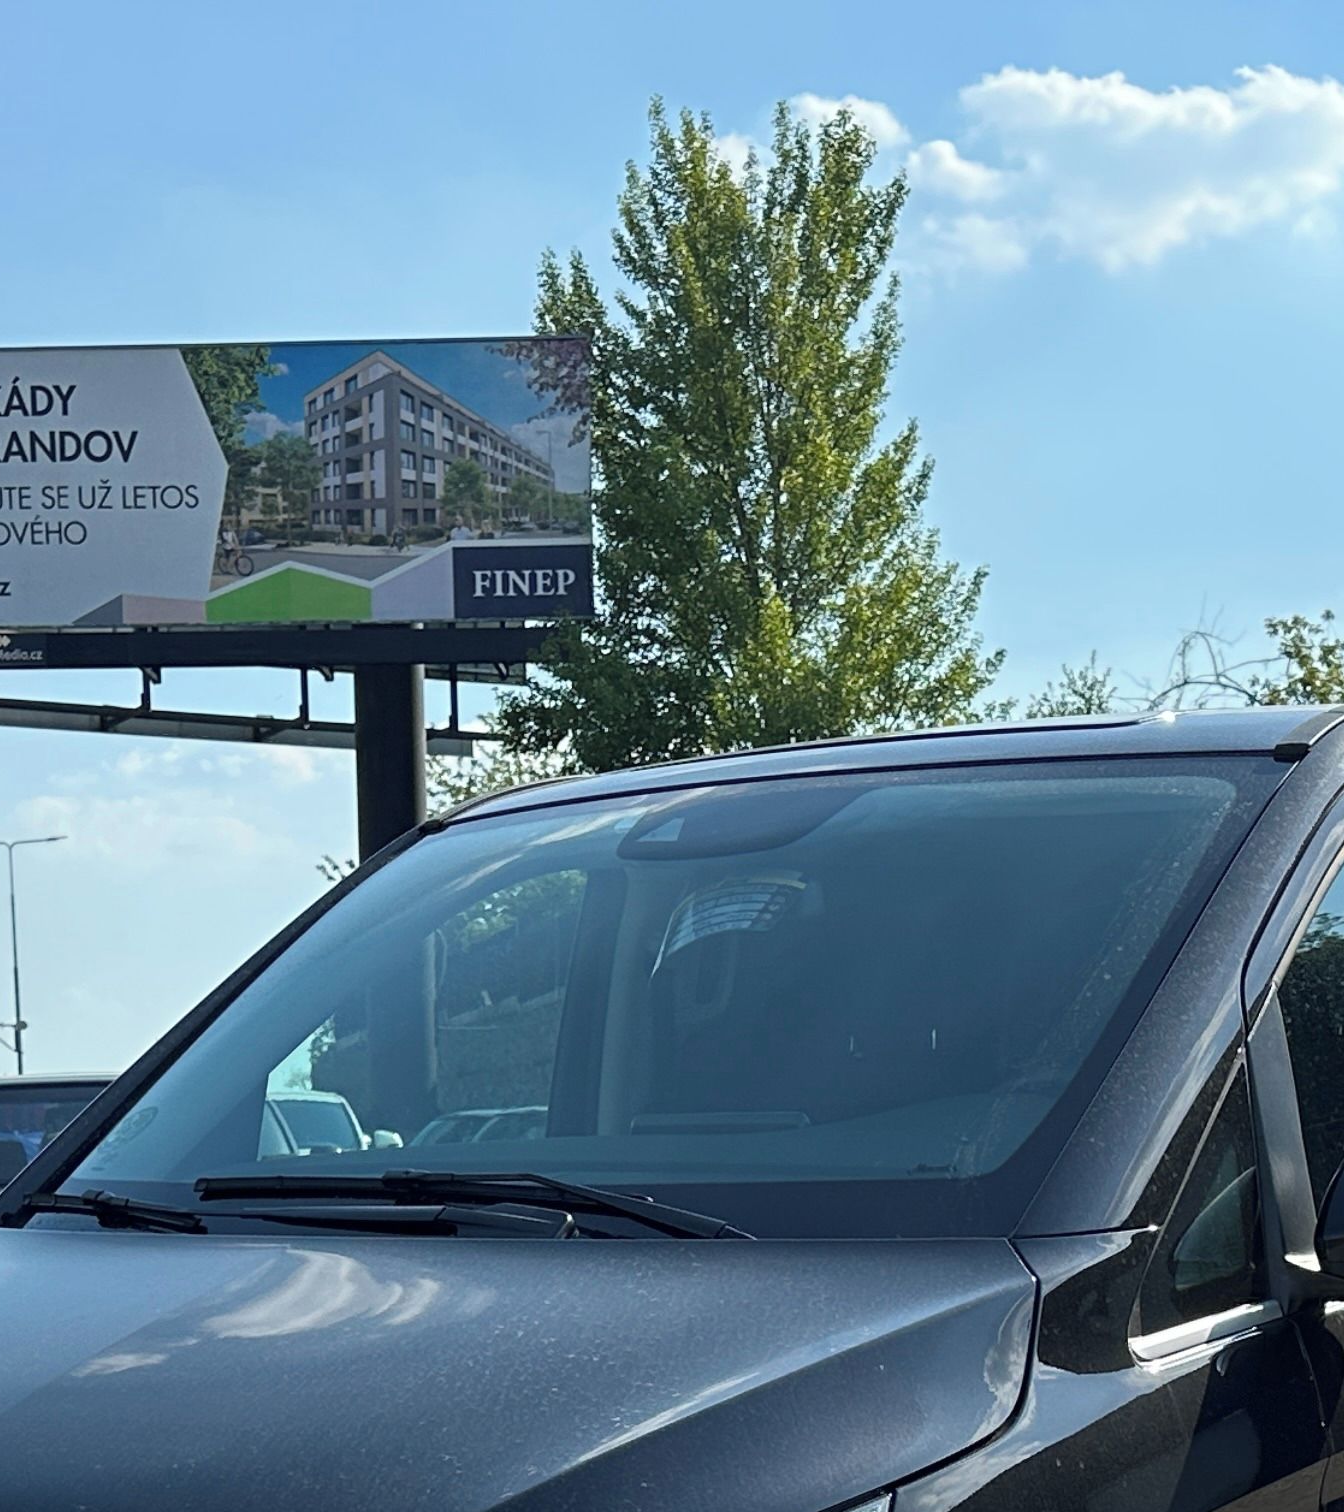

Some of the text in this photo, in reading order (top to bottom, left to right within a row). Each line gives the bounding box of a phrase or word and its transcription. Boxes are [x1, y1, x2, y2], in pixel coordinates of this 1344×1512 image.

[41, 485, 70, 510] SE
[78, 479, 113, 509] UŽ
[122, 484, 199, 509] LETOS
[472, 568, 576, 598] FINEP
